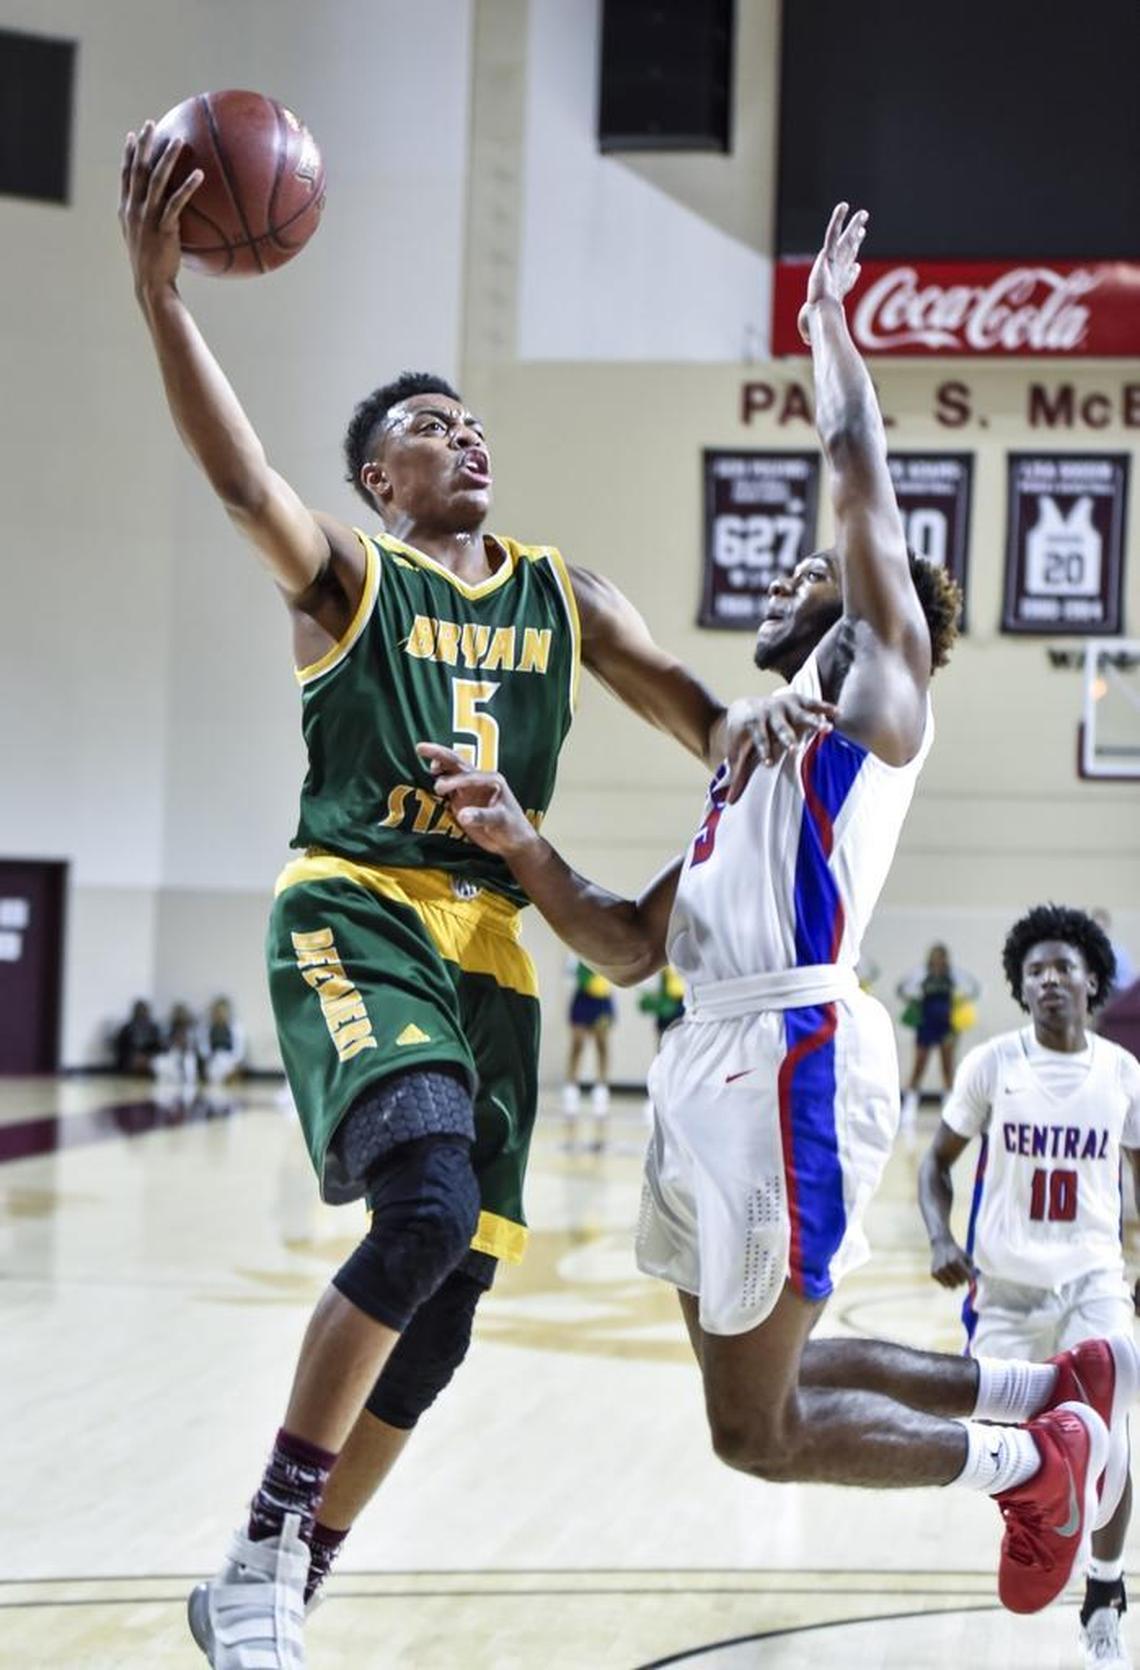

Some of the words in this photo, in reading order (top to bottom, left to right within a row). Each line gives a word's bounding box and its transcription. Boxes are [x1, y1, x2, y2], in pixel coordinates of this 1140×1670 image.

[935, 380, 989, 429] S.
[714, 513, 805, 570] 627
[1045, 551, 1084, 585] 20
[405, 614, 552, 674] BRYAN
[451, 676, 501, 773] 5
[1003, 1122, 1109, 1160] CENTRAL
[1029, 1167, 1078, 1221] 10
